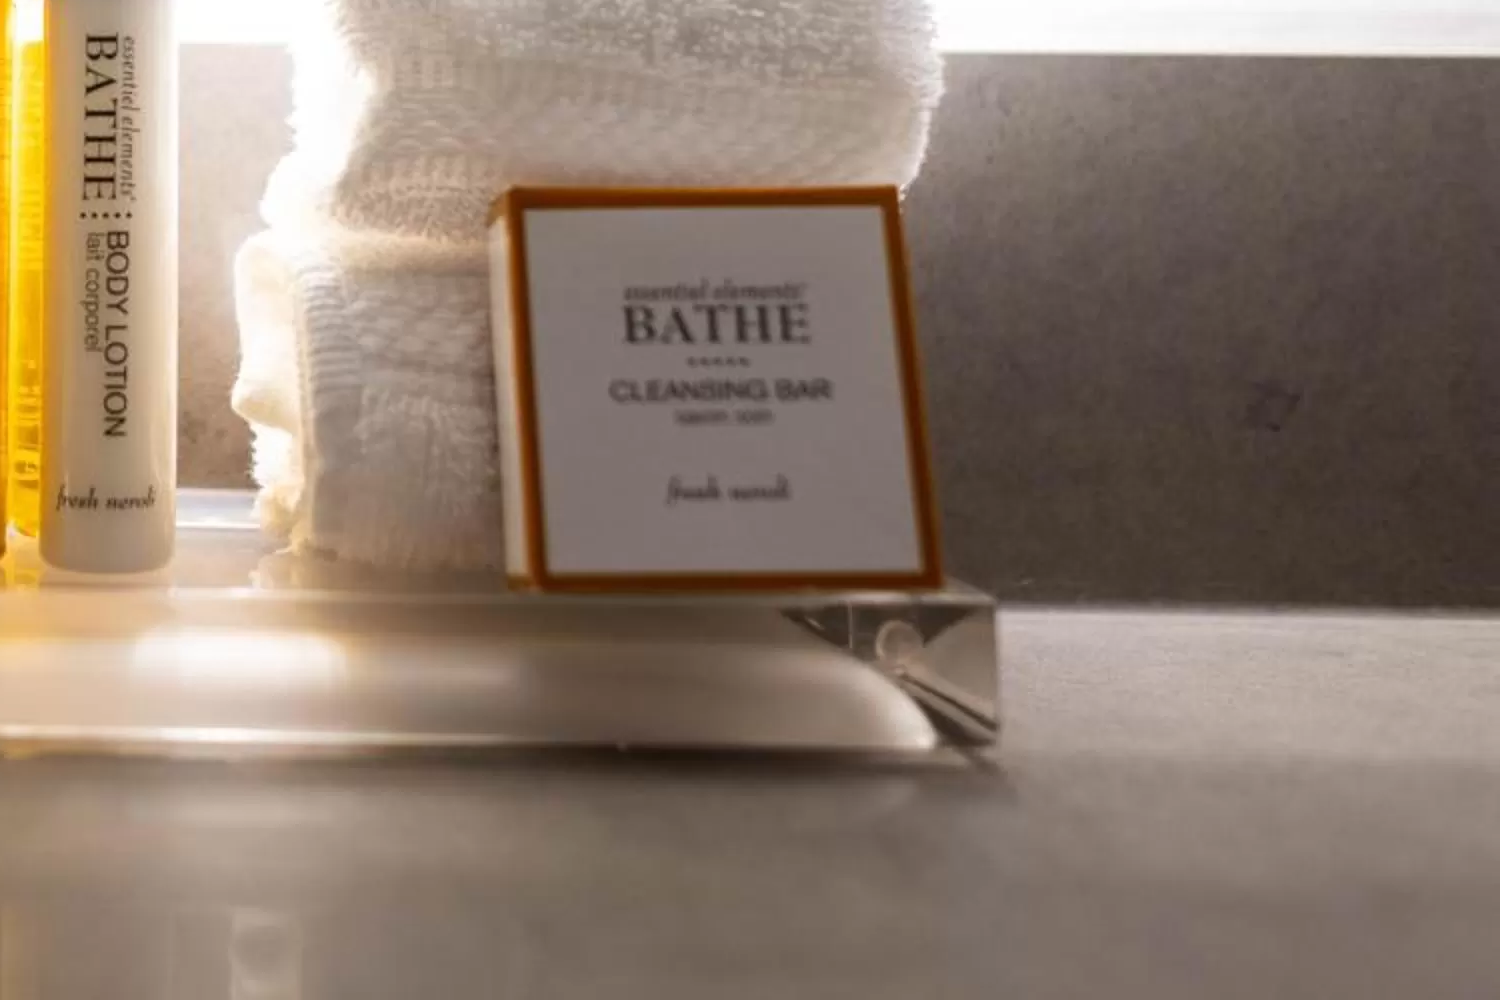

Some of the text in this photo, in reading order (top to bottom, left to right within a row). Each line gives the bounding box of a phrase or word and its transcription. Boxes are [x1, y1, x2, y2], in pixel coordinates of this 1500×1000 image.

[83, 32, 118, 200] BATHE
[80, 231, 105, 353] lait corporel
[103, 230, 130, 438] BODY LOTION
[622, 303, 812, 345] BATHE
[608, 378, 834, 405] CLEANSING BAR
